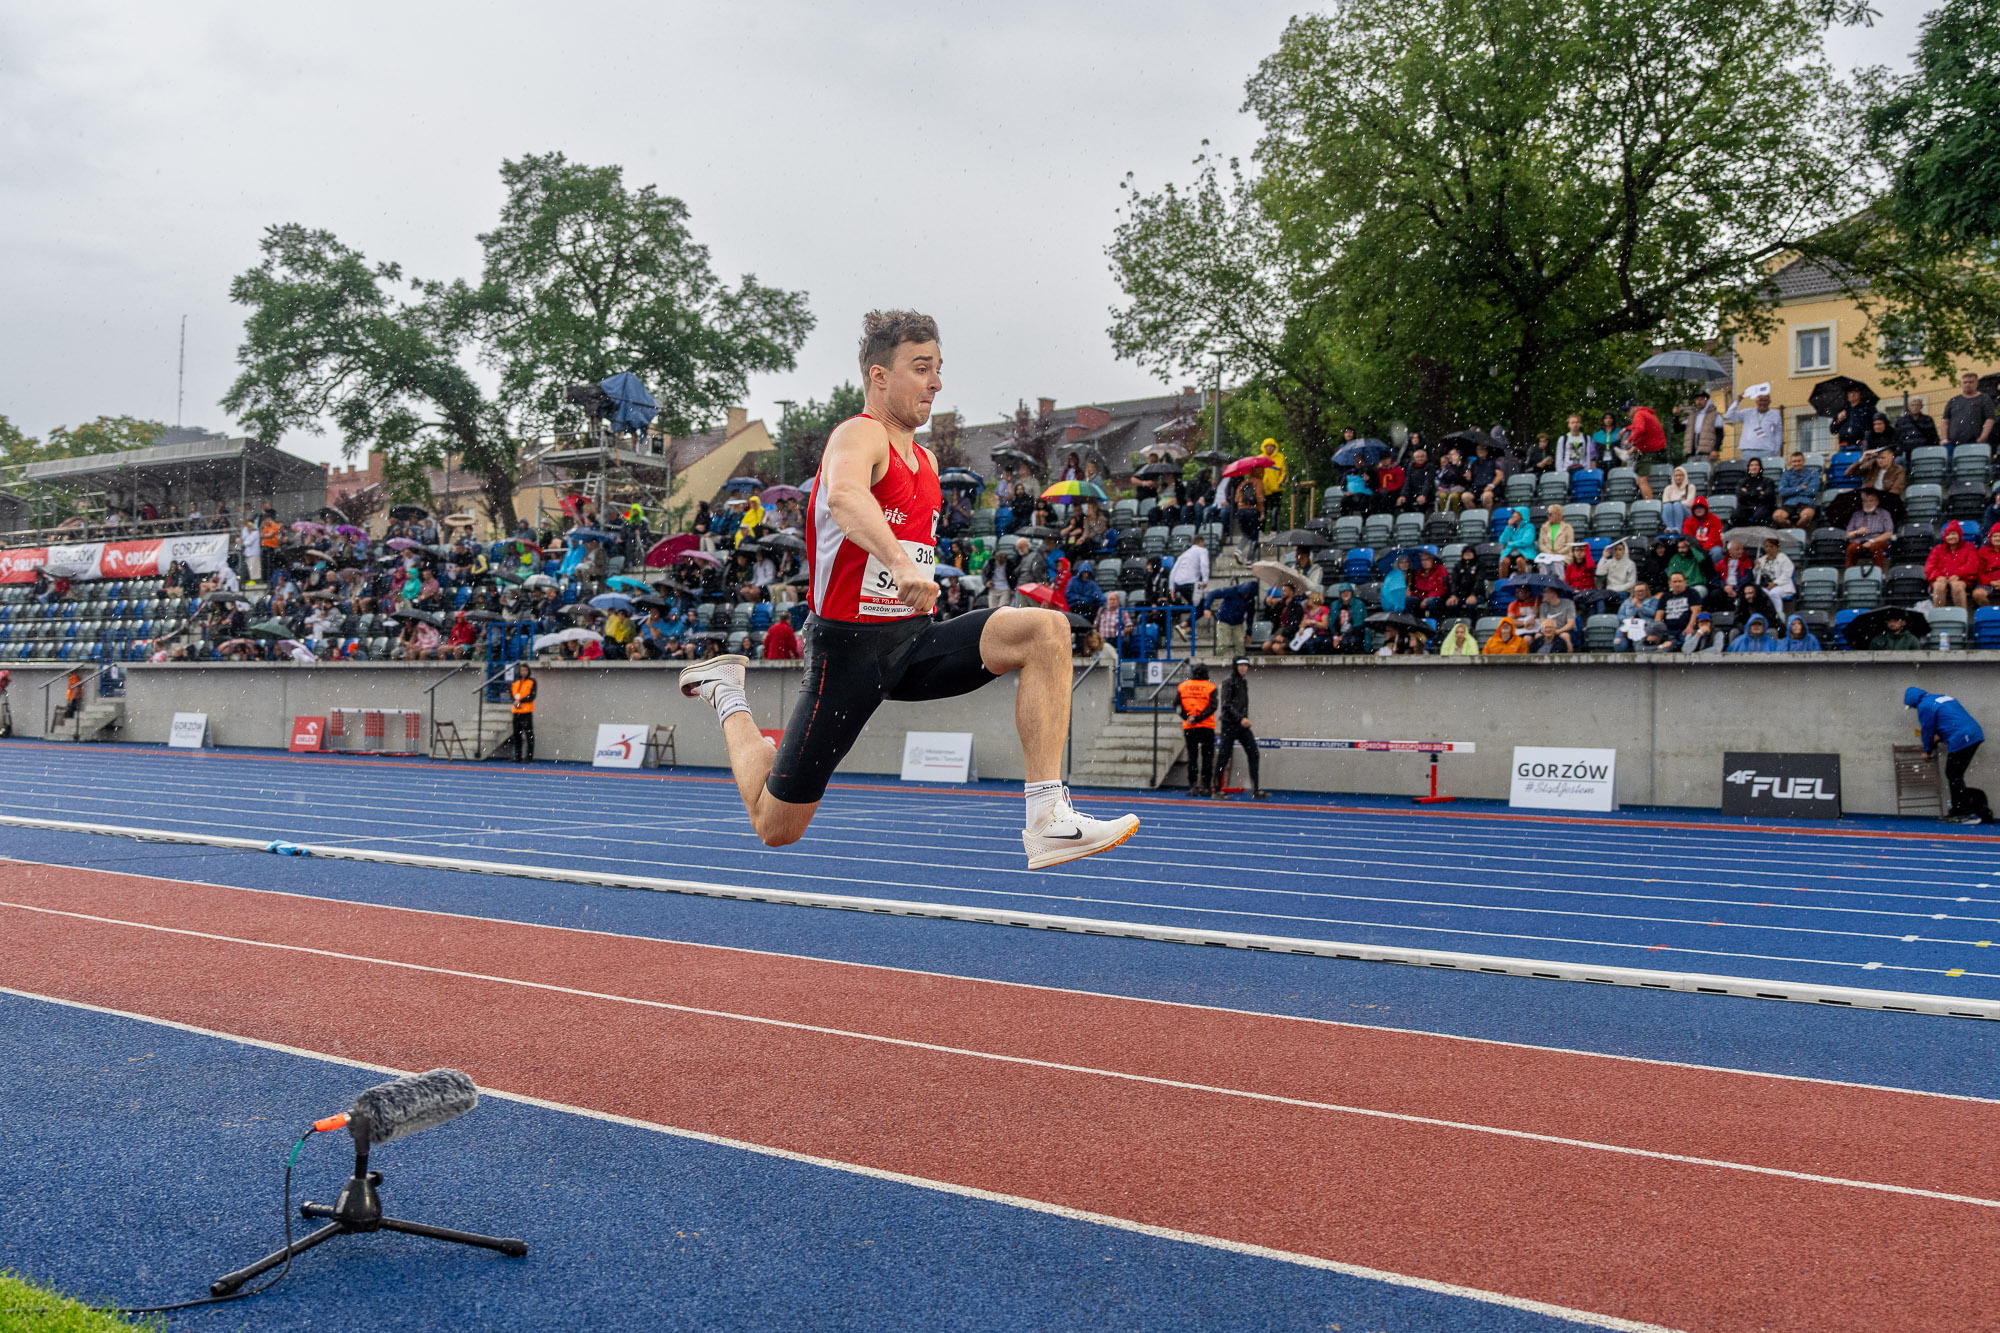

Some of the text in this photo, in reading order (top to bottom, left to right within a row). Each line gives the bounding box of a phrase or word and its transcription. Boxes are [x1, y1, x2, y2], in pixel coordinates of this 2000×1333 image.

[125, 550, 157, 566] ORLEN
[915, 548, 934, 565] 316
[876, 571, 899, 591] SA
[863, 605, 890, 613] GORZÓW
[1151, 665, 1159, 677] 6
[1518, 760, 1608, 779] GORZÓW
[1726, 770, 1836, 800] 4F FUEL
